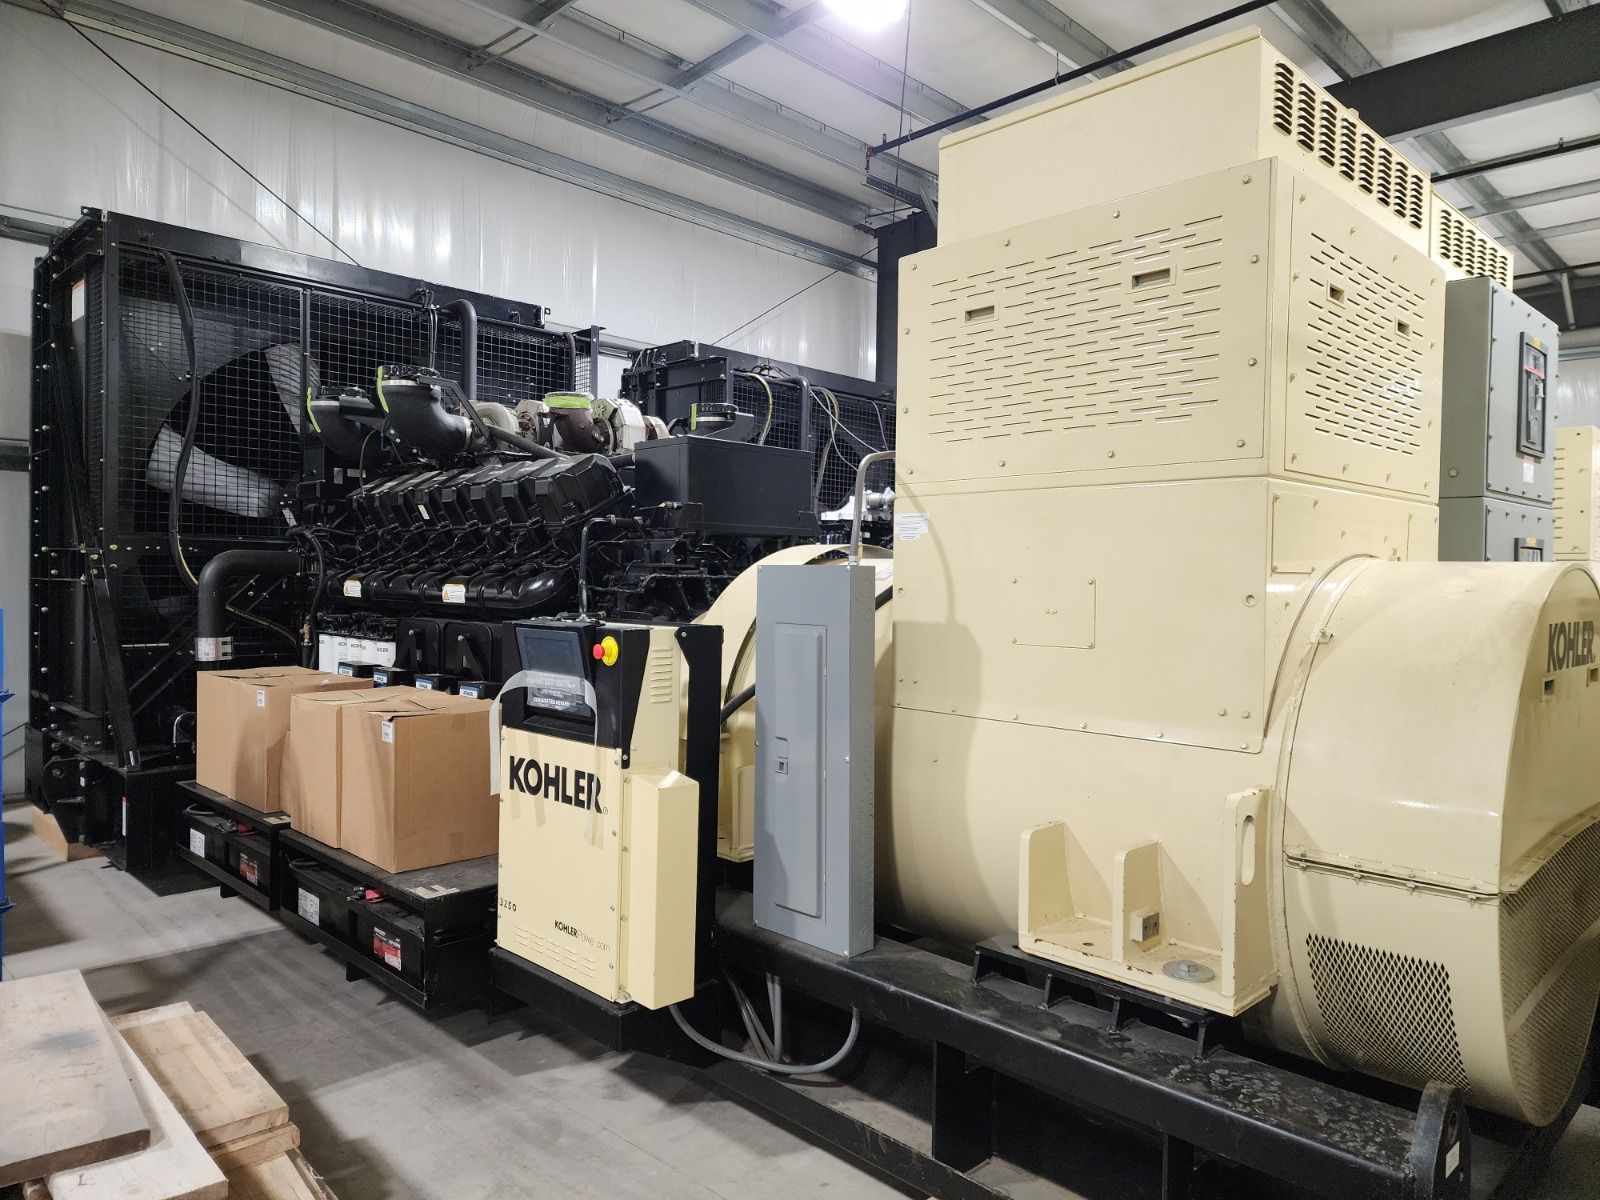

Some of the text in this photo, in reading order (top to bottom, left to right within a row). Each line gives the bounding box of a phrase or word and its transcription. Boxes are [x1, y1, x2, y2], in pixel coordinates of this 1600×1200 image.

[1546, 621, 1594, 673] KOHLER
[509, 755, 603, 814] KOHLER
[499, 897, 517, 912] 3250
